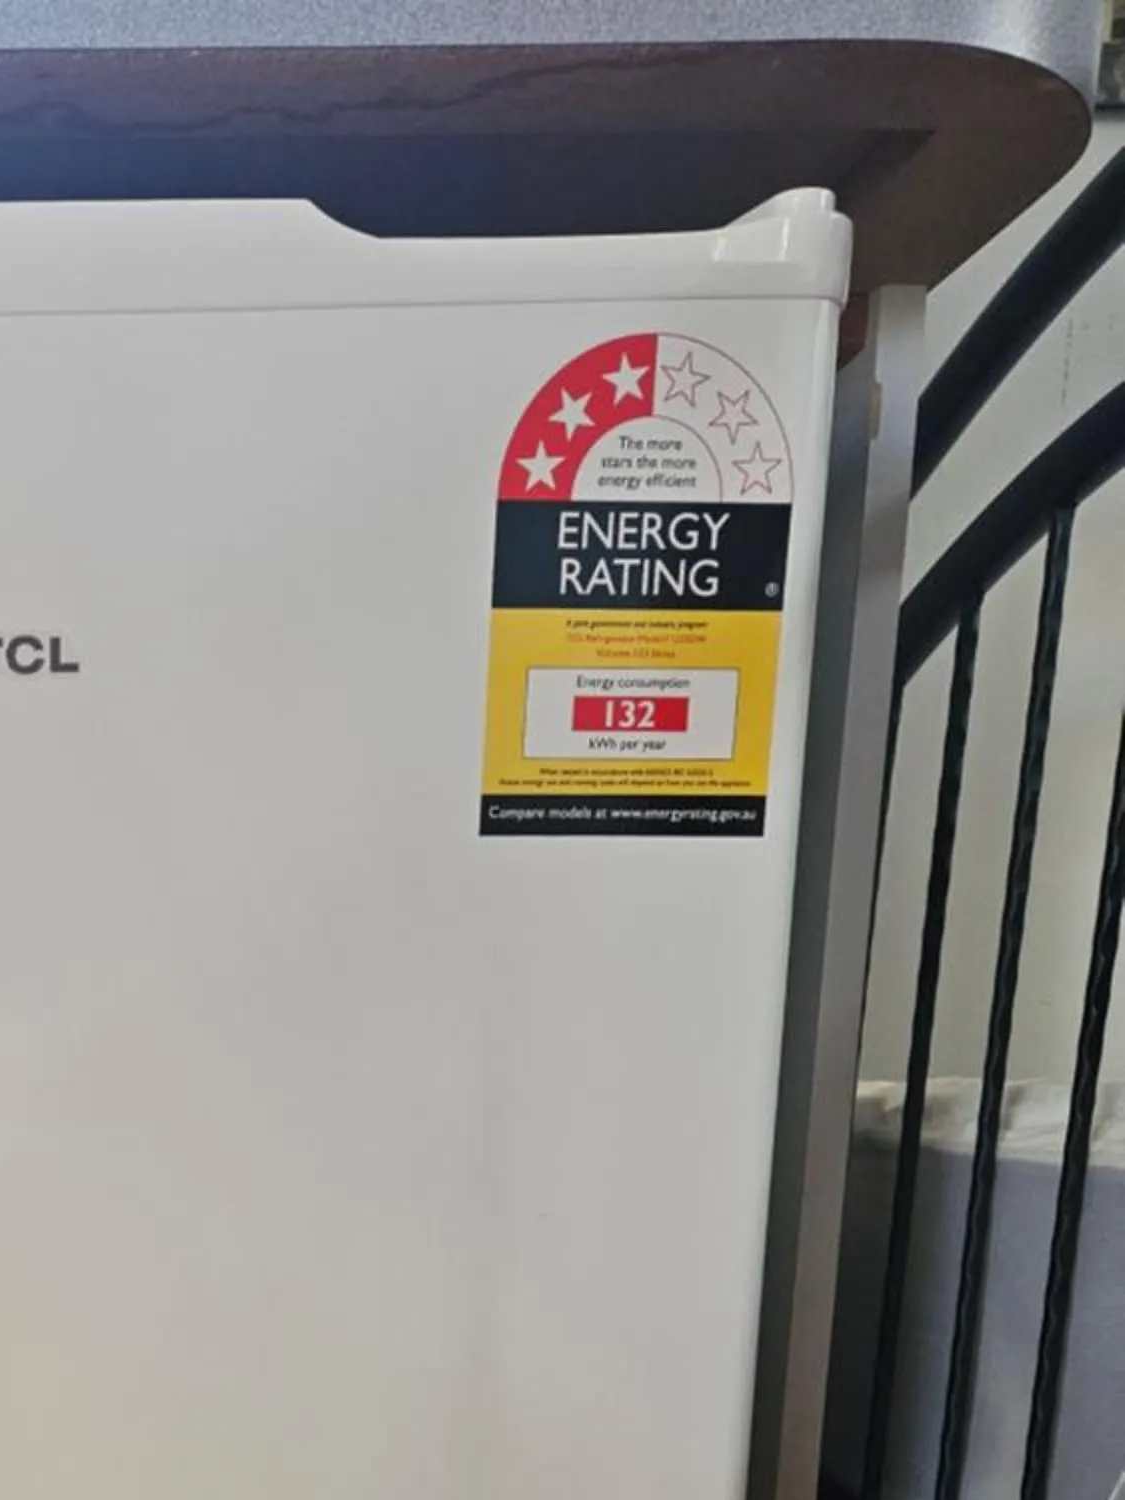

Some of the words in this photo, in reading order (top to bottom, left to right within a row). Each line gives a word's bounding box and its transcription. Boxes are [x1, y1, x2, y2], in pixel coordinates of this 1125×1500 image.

[619, 435, 643, 450] The
[647, 440, 683, 451] more
[600, 456, 633, 469] stars
[636, 454, 658, 469] the
[661, 458, 697, 470] more
[597, 475, 641, 490] energy
[645, 473, 697, 488] efficient
[557, 511, 731, 551] ENERGY
[559, 558, 720, 597] RATING
[576, 674, 615, 691] Energy
[617, 677, 692, 691] consumption
[604, 699, 657, 729] 132
[588, 737, 617, 750] kWh
[619, 740, 639, 752] per
[642, 740, 667, 752] year
[487, 804, 545, 822] Compare
[548, 804, 592, 820] models
[594, 806, 608, 820] at
[611, 808, 758, 823] www.energyrating.gov.au
